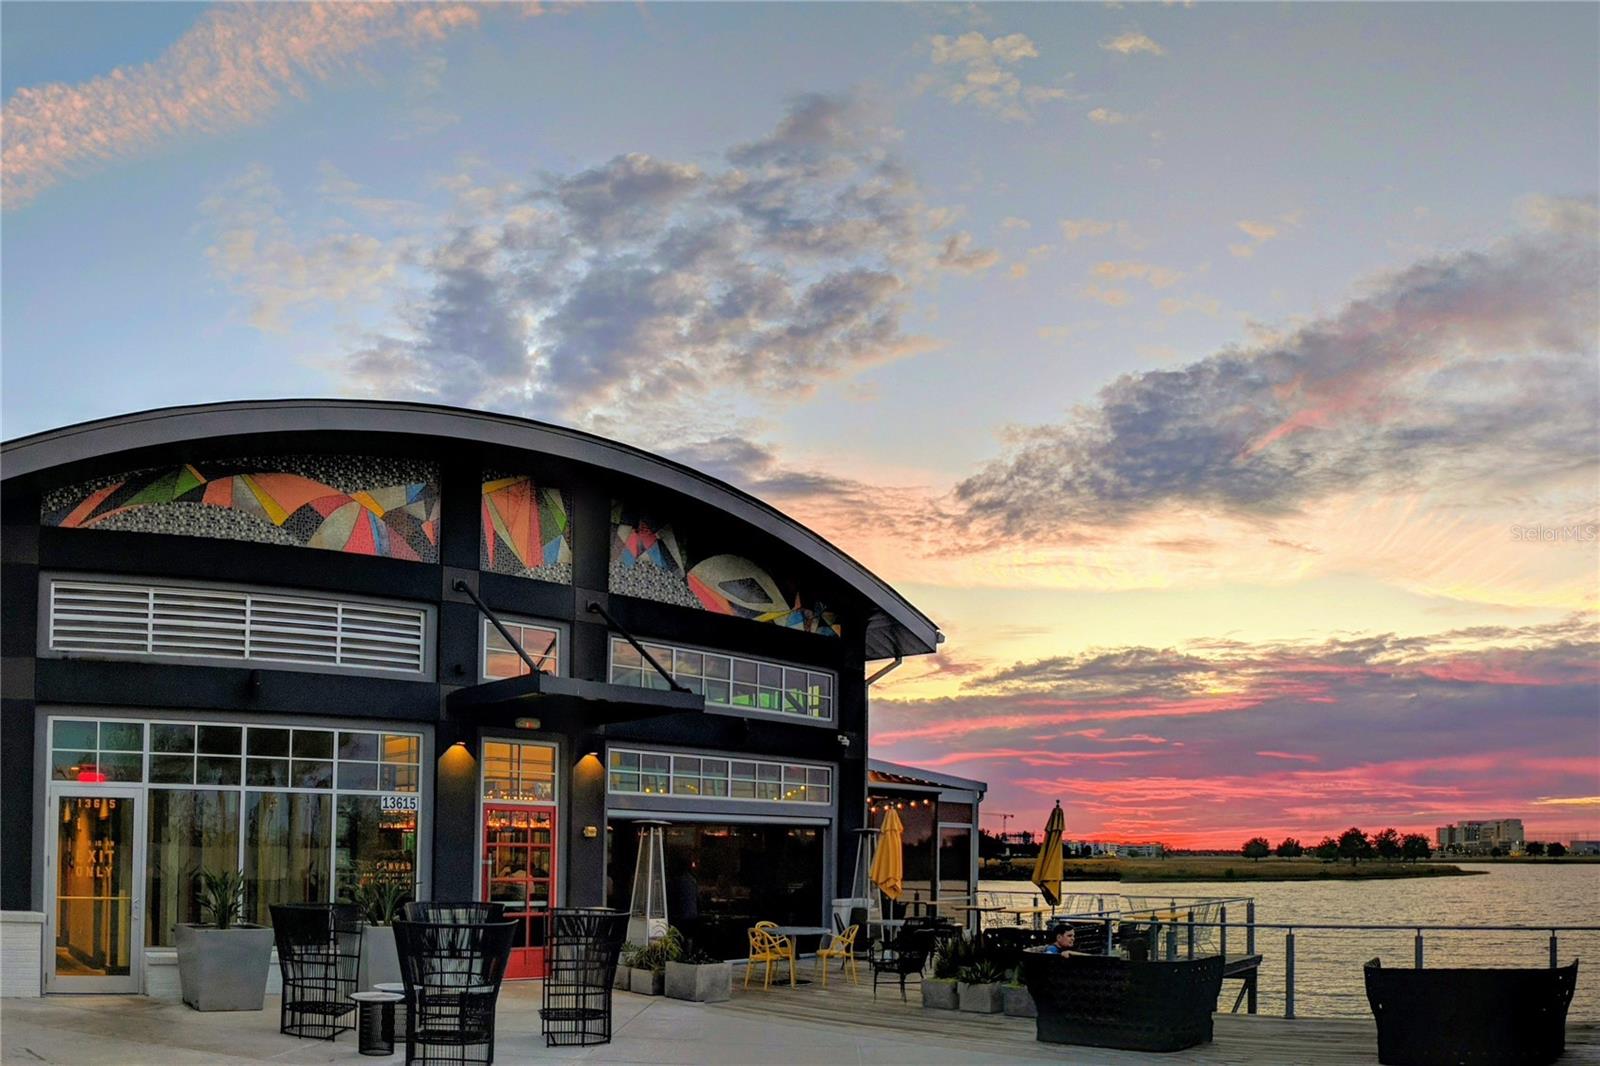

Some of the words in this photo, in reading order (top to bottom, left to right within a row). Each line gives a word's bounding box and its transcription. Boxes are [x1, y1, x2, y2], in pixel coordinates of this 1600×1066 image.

[78, 799, 116, 808] 1365
[382, 797, 416, 809] 13615
[76, 866, 113, 877] ONLY
